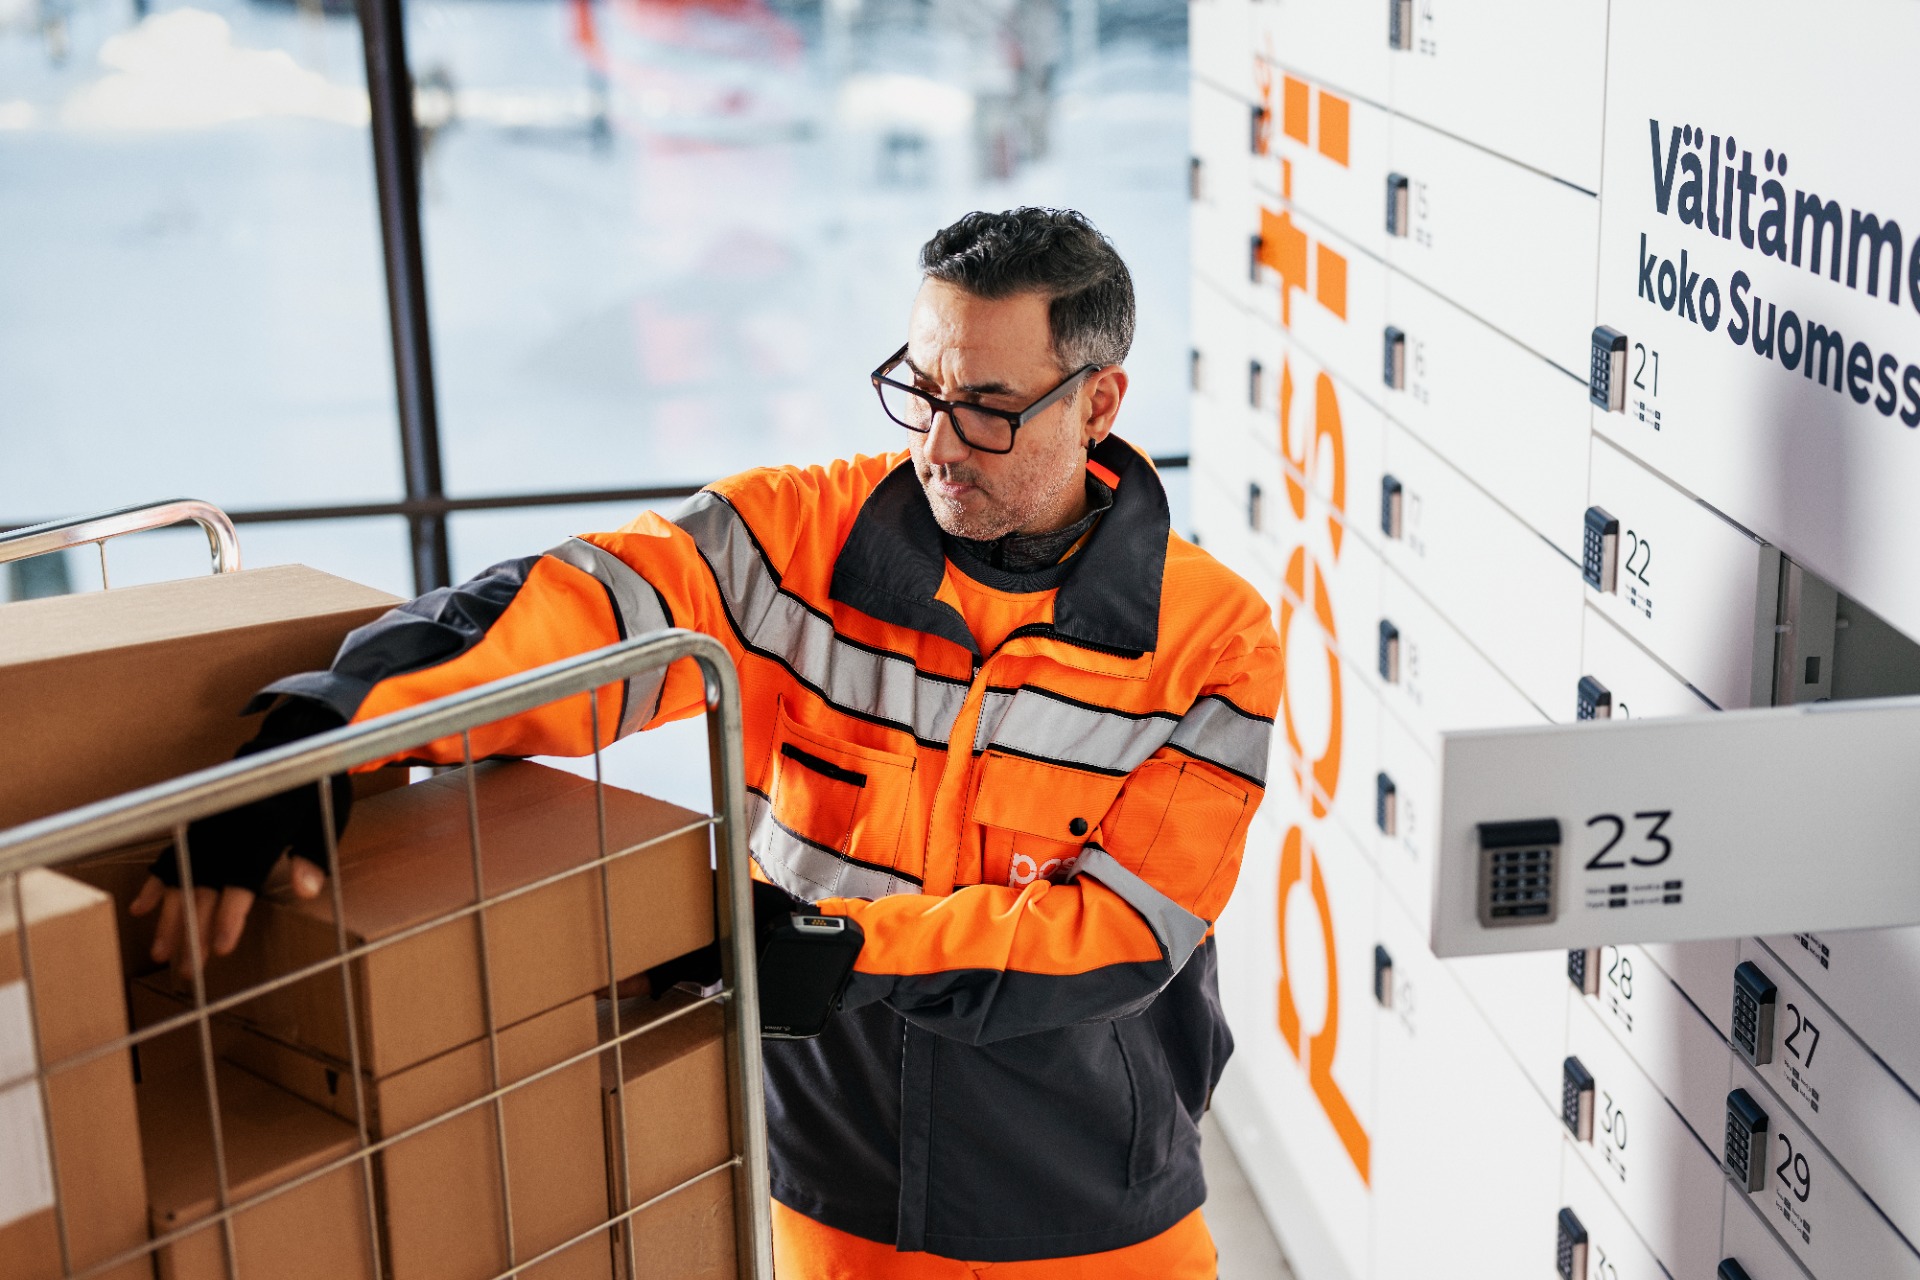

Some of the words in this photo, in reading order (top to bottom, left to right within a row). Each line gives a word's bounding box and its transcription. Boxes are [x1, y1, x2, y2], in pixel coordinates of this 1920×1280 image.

[1638, 232, 1721, 333] koko
[1726, 269, 1920, 429] Suomess
[1633, 342, 1659, 397] 21
[1625, 529, 1651, 587] 22
[1256, 74, 1371, 1187] posti
[1584, 810, 1673, 871] 23
[1607, 945, 1633, 1000] 28
[1784, 1003, 1820, 1069] 27
[1601, 1091, 1627, 1150] 30
[1776, 1133, 1811, 1203] 29
